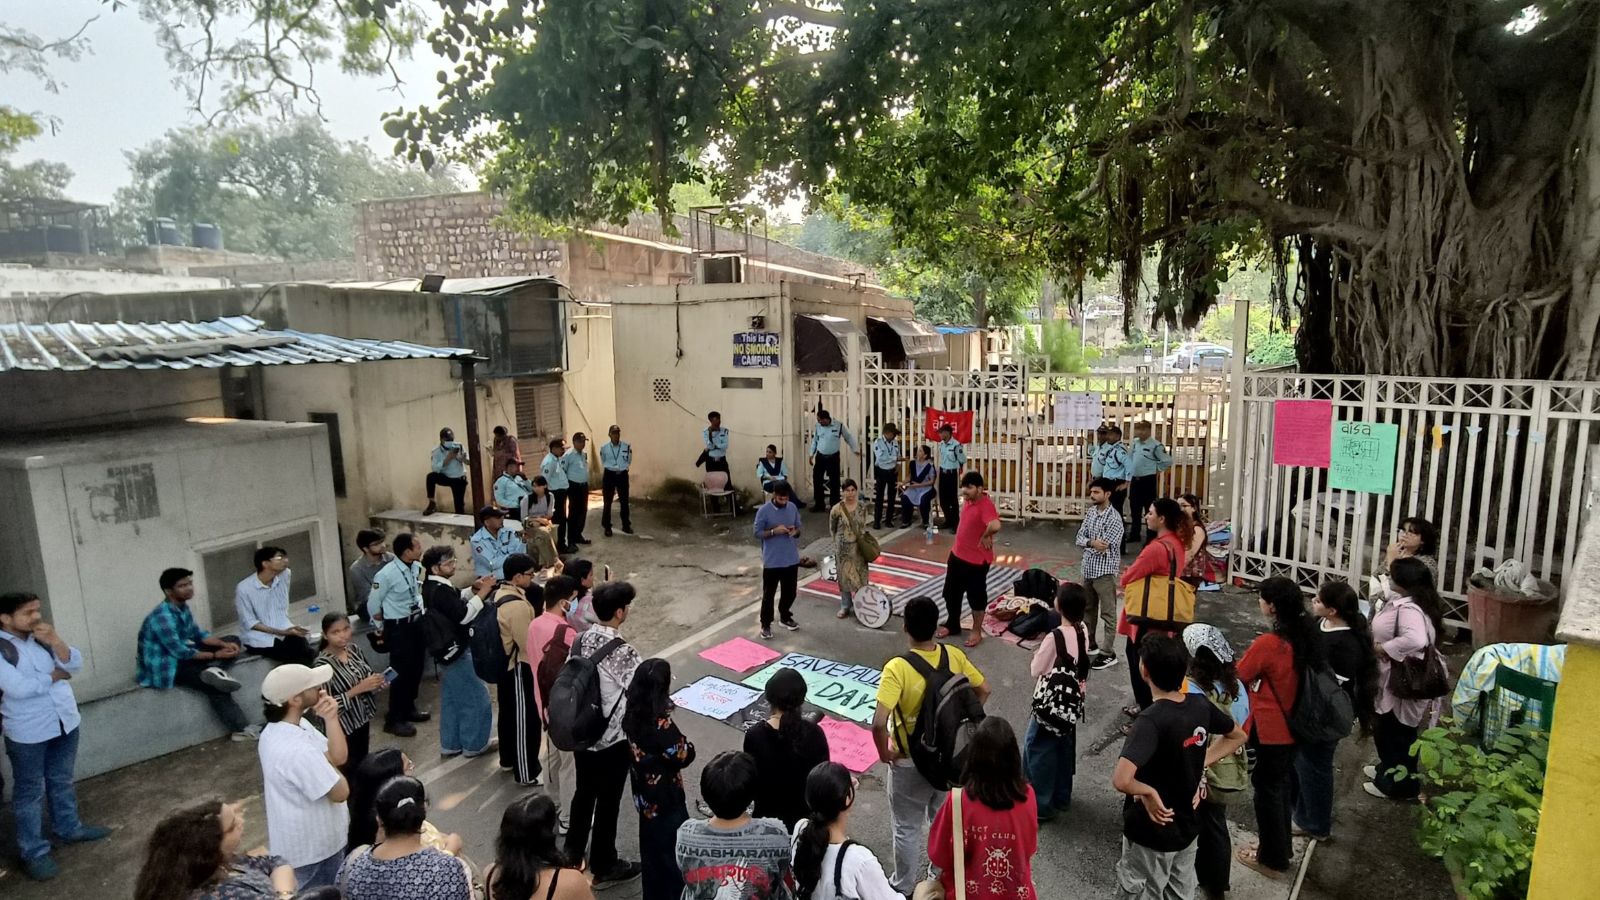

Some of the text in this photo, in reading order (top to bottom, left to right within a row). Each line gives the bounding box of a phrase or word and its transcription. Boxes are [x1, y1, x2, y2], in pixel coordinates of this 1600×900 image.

[742, 334, 765, 342] This is
[734, 344, 780, 355] NO SMOKING
[741, 355, 772, 366] CAMPUS
[932, 415, 958, 433] aia
[1341, 421, 1371, 437] aisa
[780, 655, 849, 678] SAVE
